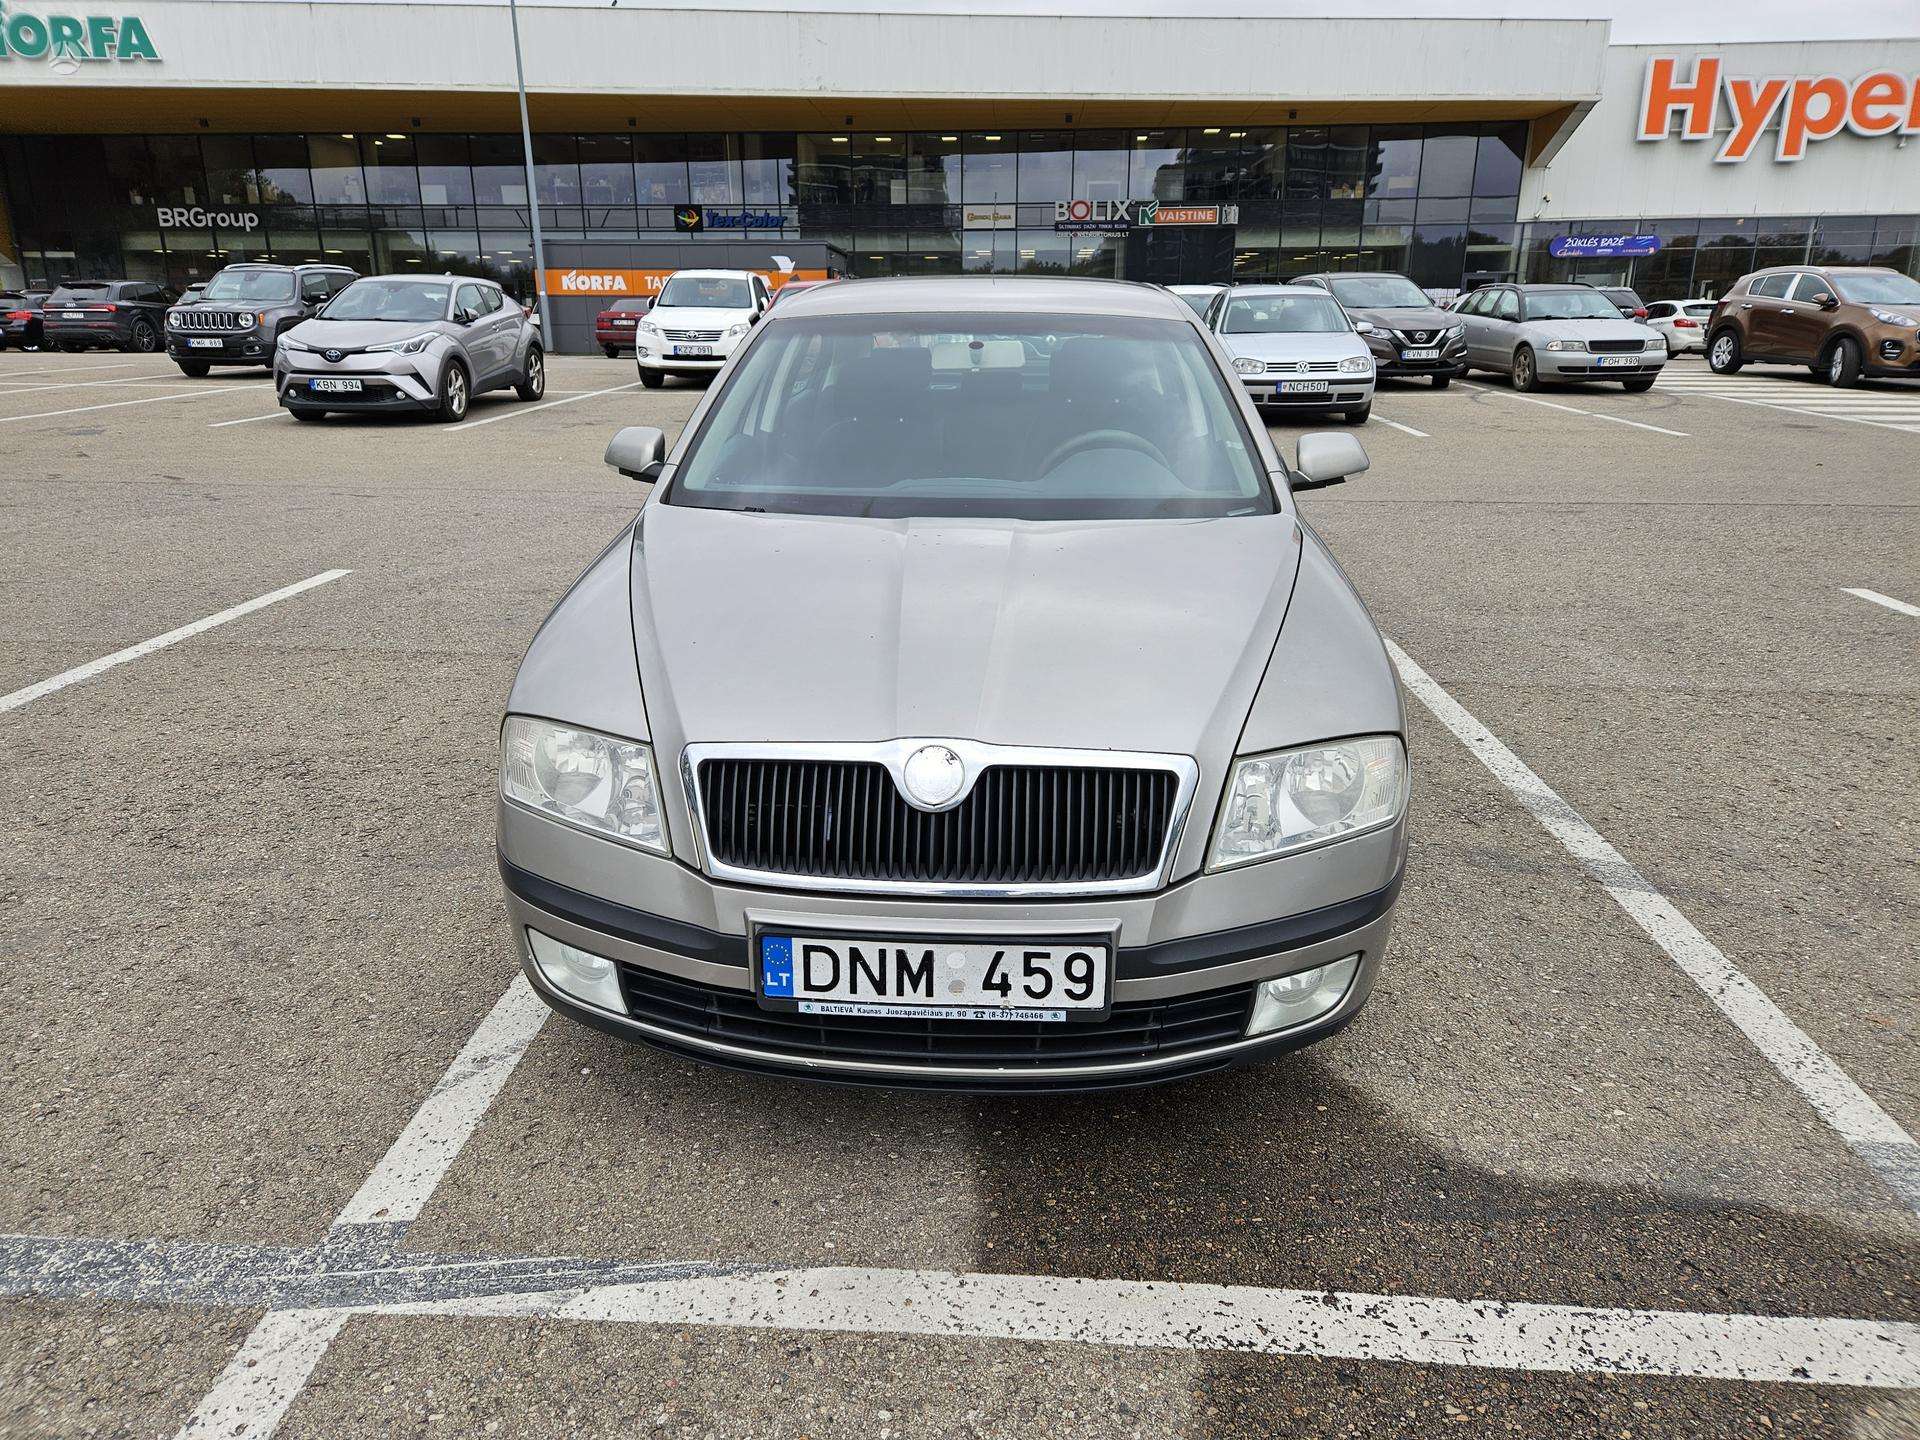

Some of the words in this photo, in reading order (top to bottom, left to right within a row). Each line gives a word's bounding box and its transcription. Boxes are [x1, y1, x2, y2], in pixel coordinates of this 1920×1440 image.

[0, 8, 162, 62] ORFA
[157, 207, 259, 232] BRGroup
[1055, 200, 1131, 221] BOLIX
[561, 270, 627, 291] NORFA
[315, 380, 337, 390] KBN
[341, 380, 360, 390] 994
[1289, 382, 1327, 391] NCH501
[766, 972, 790, 987] LT
[802, 944, 934, 997] DNM
[981, 951, 1095, 1000] 459
[820, 1005, 853, 1014] BALTIEVA
[857, 1007, 882, 1015] Kaunas
[885, 1008, 943, 1017] Juozapavičiaus
[957, 1010, 967, 1018] 90
